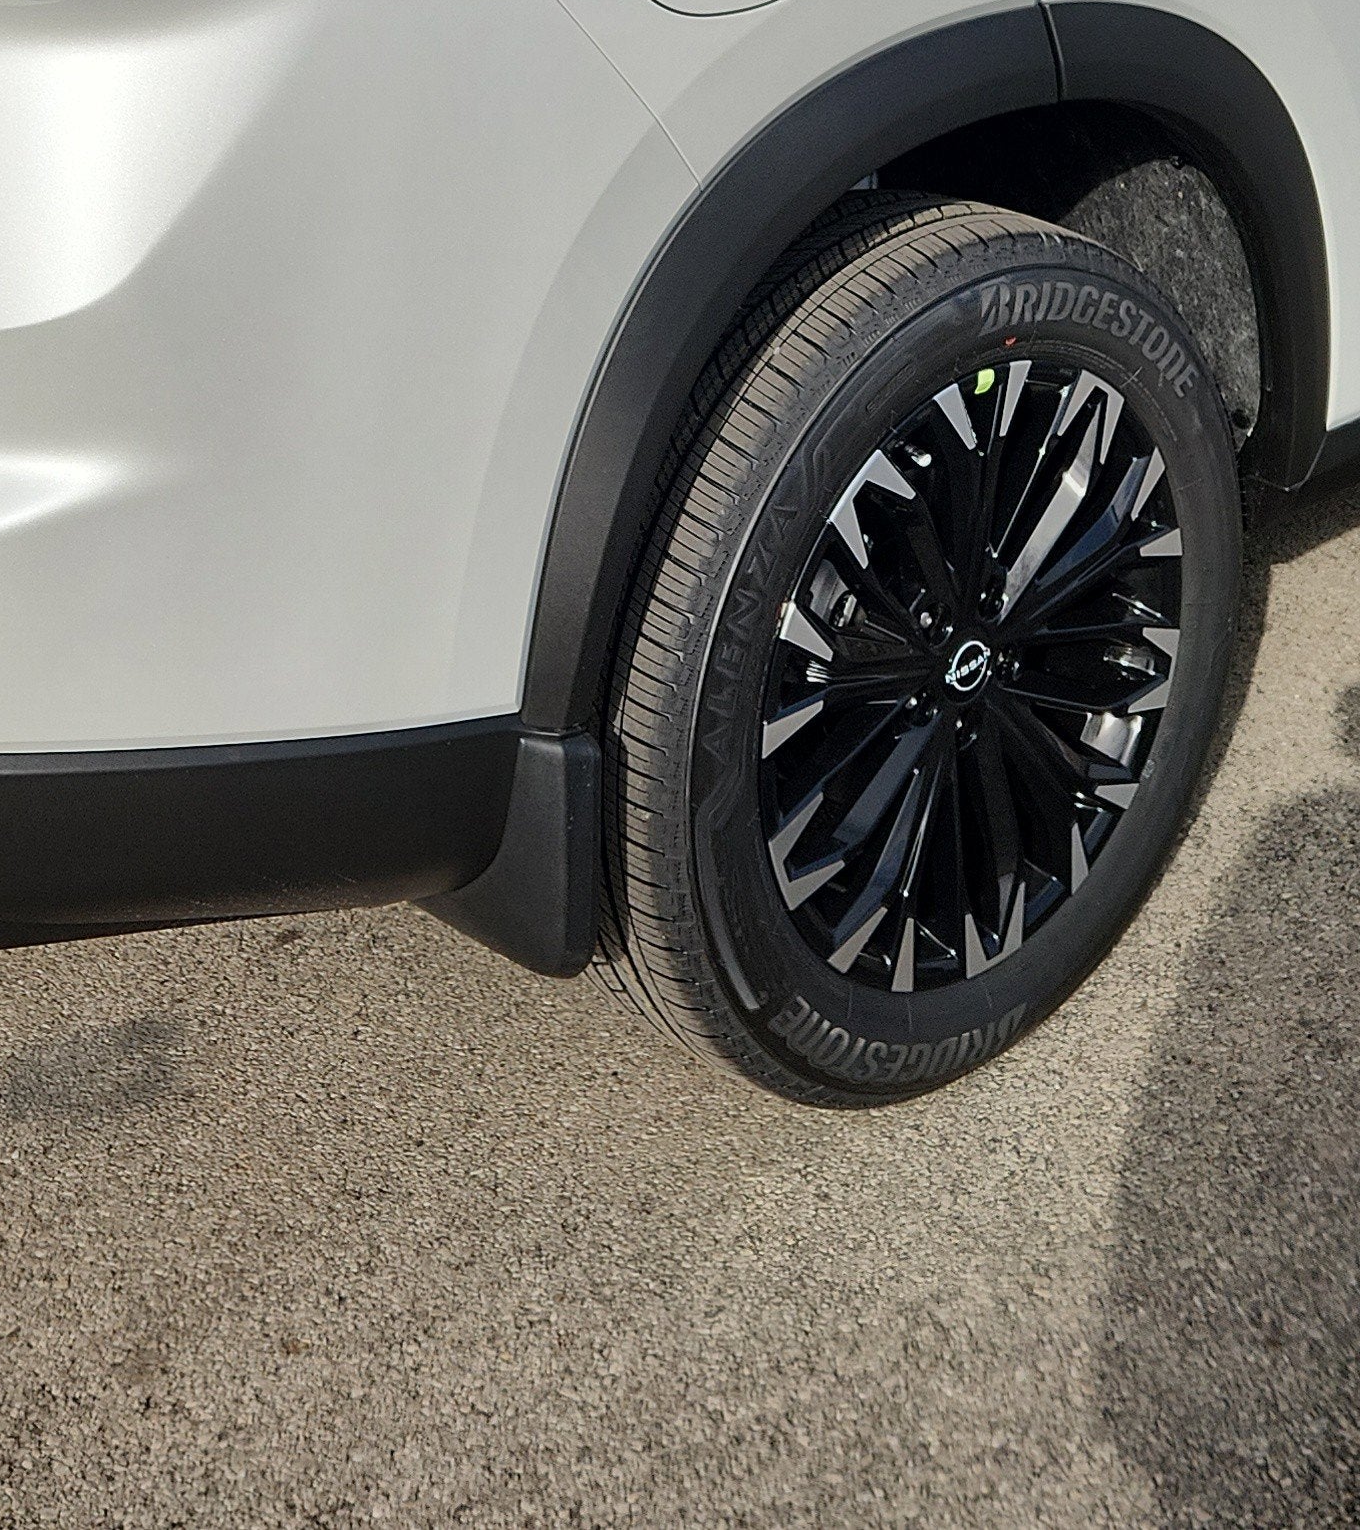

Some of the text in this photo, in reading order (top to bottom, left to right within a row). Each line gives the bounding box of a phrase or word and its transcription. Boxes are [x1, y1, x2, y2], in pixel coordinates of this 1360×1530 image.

[977, 280, 1200, 400] BRIDGESTONE
[700, 503, 799, 765] ALENZA
[945, 647, 991, 683] NISSAN
[767, 994, 1027, 1084] BRIDGESTONE
